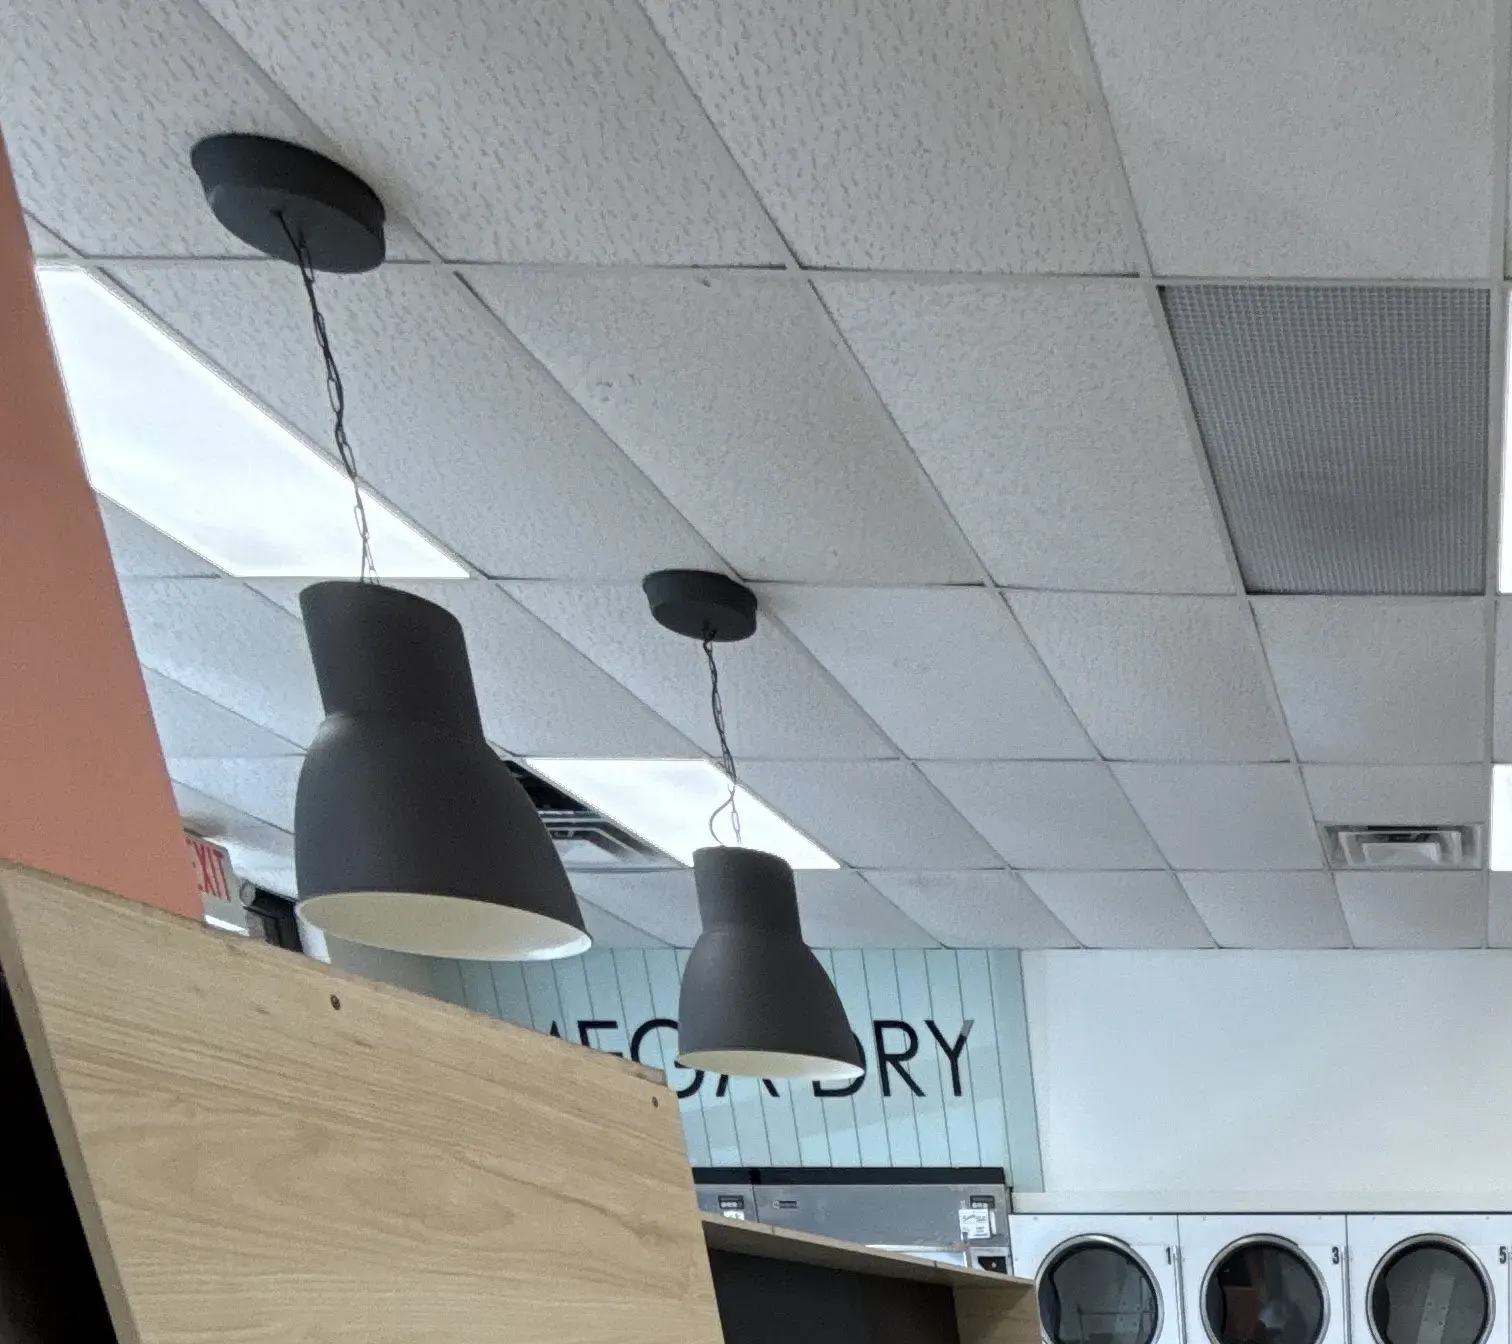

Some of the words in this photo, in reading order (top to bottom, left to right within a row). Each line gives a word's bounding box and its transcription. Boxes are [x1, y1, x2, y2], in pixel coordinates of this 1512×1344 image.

[185, 837, 231, 903] XIT
[1331, 1246, 1339, 1265] 3
[1498, 1245, 1507, 1264] 5
